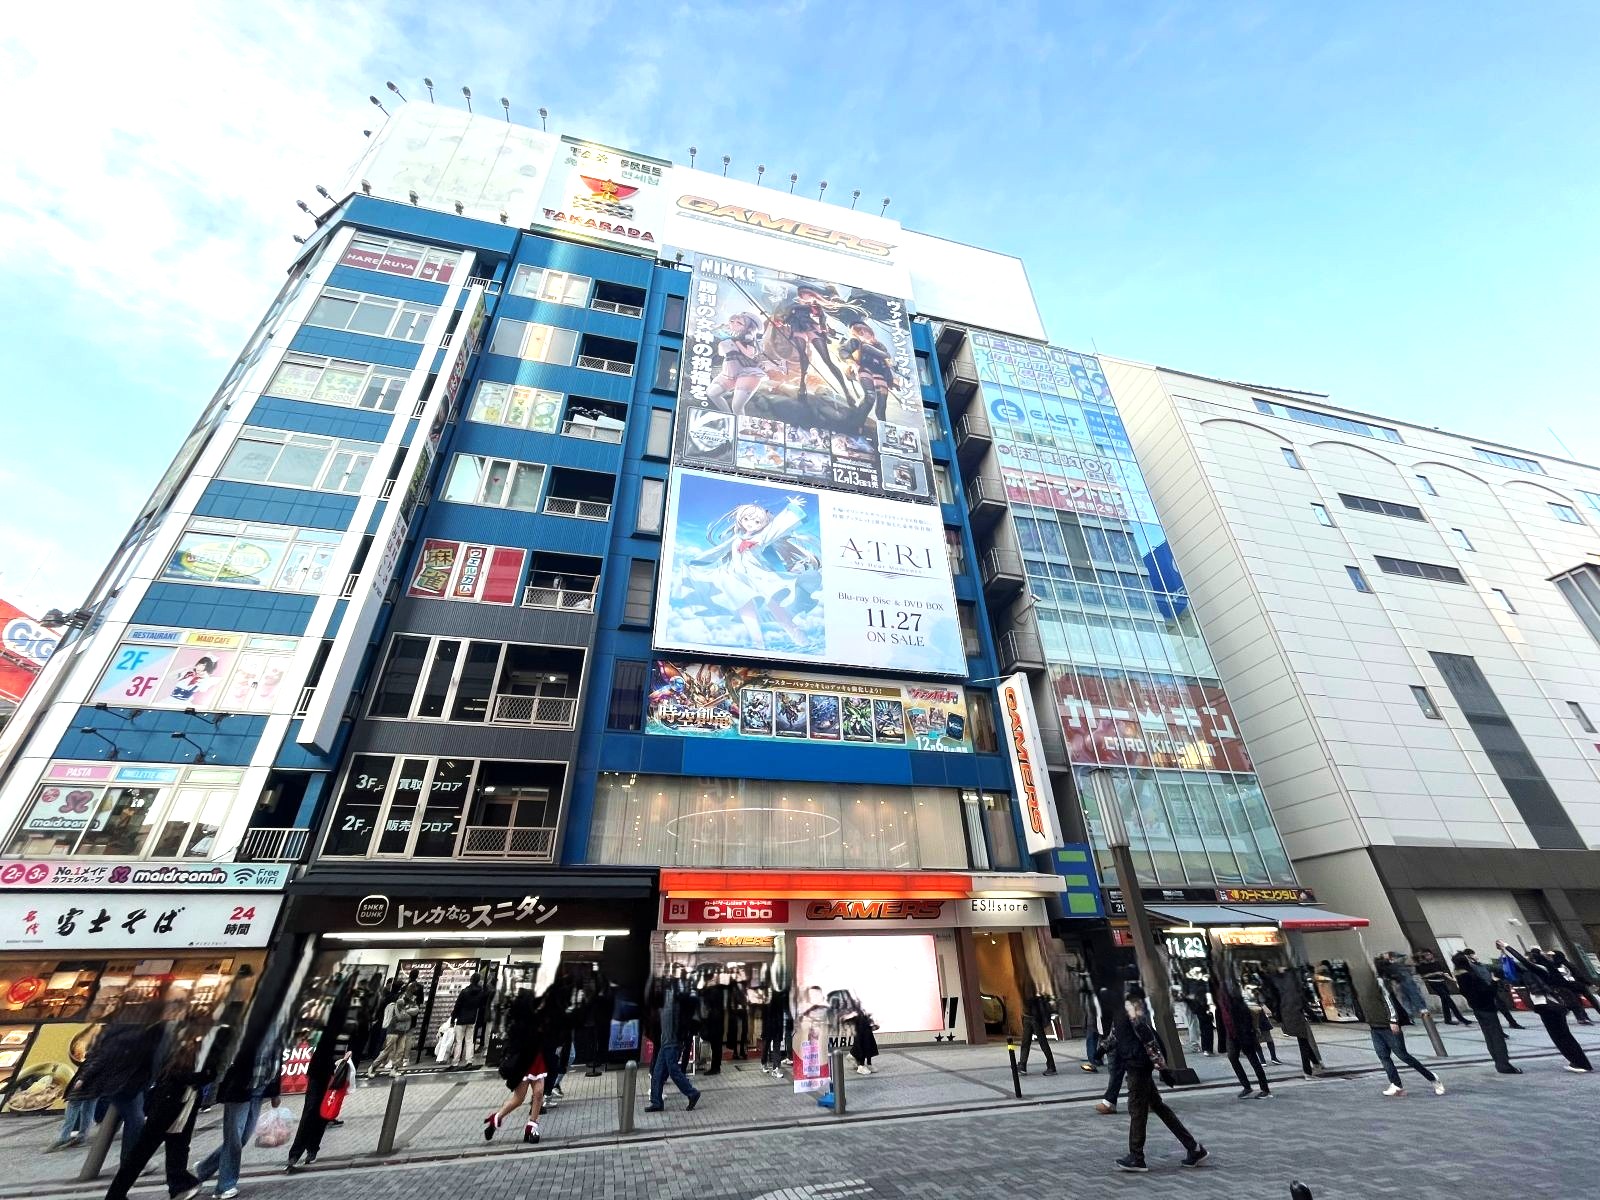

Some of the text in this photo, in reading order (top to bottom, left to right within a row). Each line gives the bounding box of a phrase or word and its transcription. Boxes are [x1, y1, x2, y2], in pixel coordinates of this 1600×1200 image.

[620, 158, 663, 178] FREE
[542, 207, 655, 243] TAKARADA
[676, 194, 899, 258] GAMERS
[346, 253, 380, 264] HARE
[383, 259, 415, 271] RUYA
[700, 258, 756, 283] NIKKE
[1029, 409, 1080, 427] EAST
[839, 537, 933, 570] ATRI
[457, 549, 483, 594] ウェルカム
[838, 591, 869, 605] Blu-ray
[872, 596, 891, 606] Disc
[903, 599, 923, 609] DVD
[925, 602, 945, 612] BOX
[866, 607, 922, 632] 11.27
[132, 631, 178, 641] RESTAURANT
[195, 634, 217, 644] MAID
[866, 630, 925, 647] ON SALE
[116, 650, 150, 671] 2F
[125, 676, 159, 698] 3F
[1004, 686, 1047, 841] GAMERS
[65, 768, 93, 777] PASTA
[355, 774, 378, 790] 3F
[341, 815, 366, 832] 2F
[5, 867, 22, 880] 2F
[29, 867, 46, 880] 3F
[51, 876, 105, 884] カフェグループ
[133, 867, 228, 884] maidreamin
[255, 876, 278, 885] WiFi
[257, 868, 280, 877] Free
[230, 906, 256, 921] 24
[360, 910, 383, 919] DUNK
[363, 903, 385, 911] SNKR
[397, 895, 559, 929] トレカならスニダン
[671, 904, 686, 915] B1
[805, 900, 945, 921] GAMERS
[55, 906, 187, 937] 富士そば
[223, 923, 252, 936] 時間
